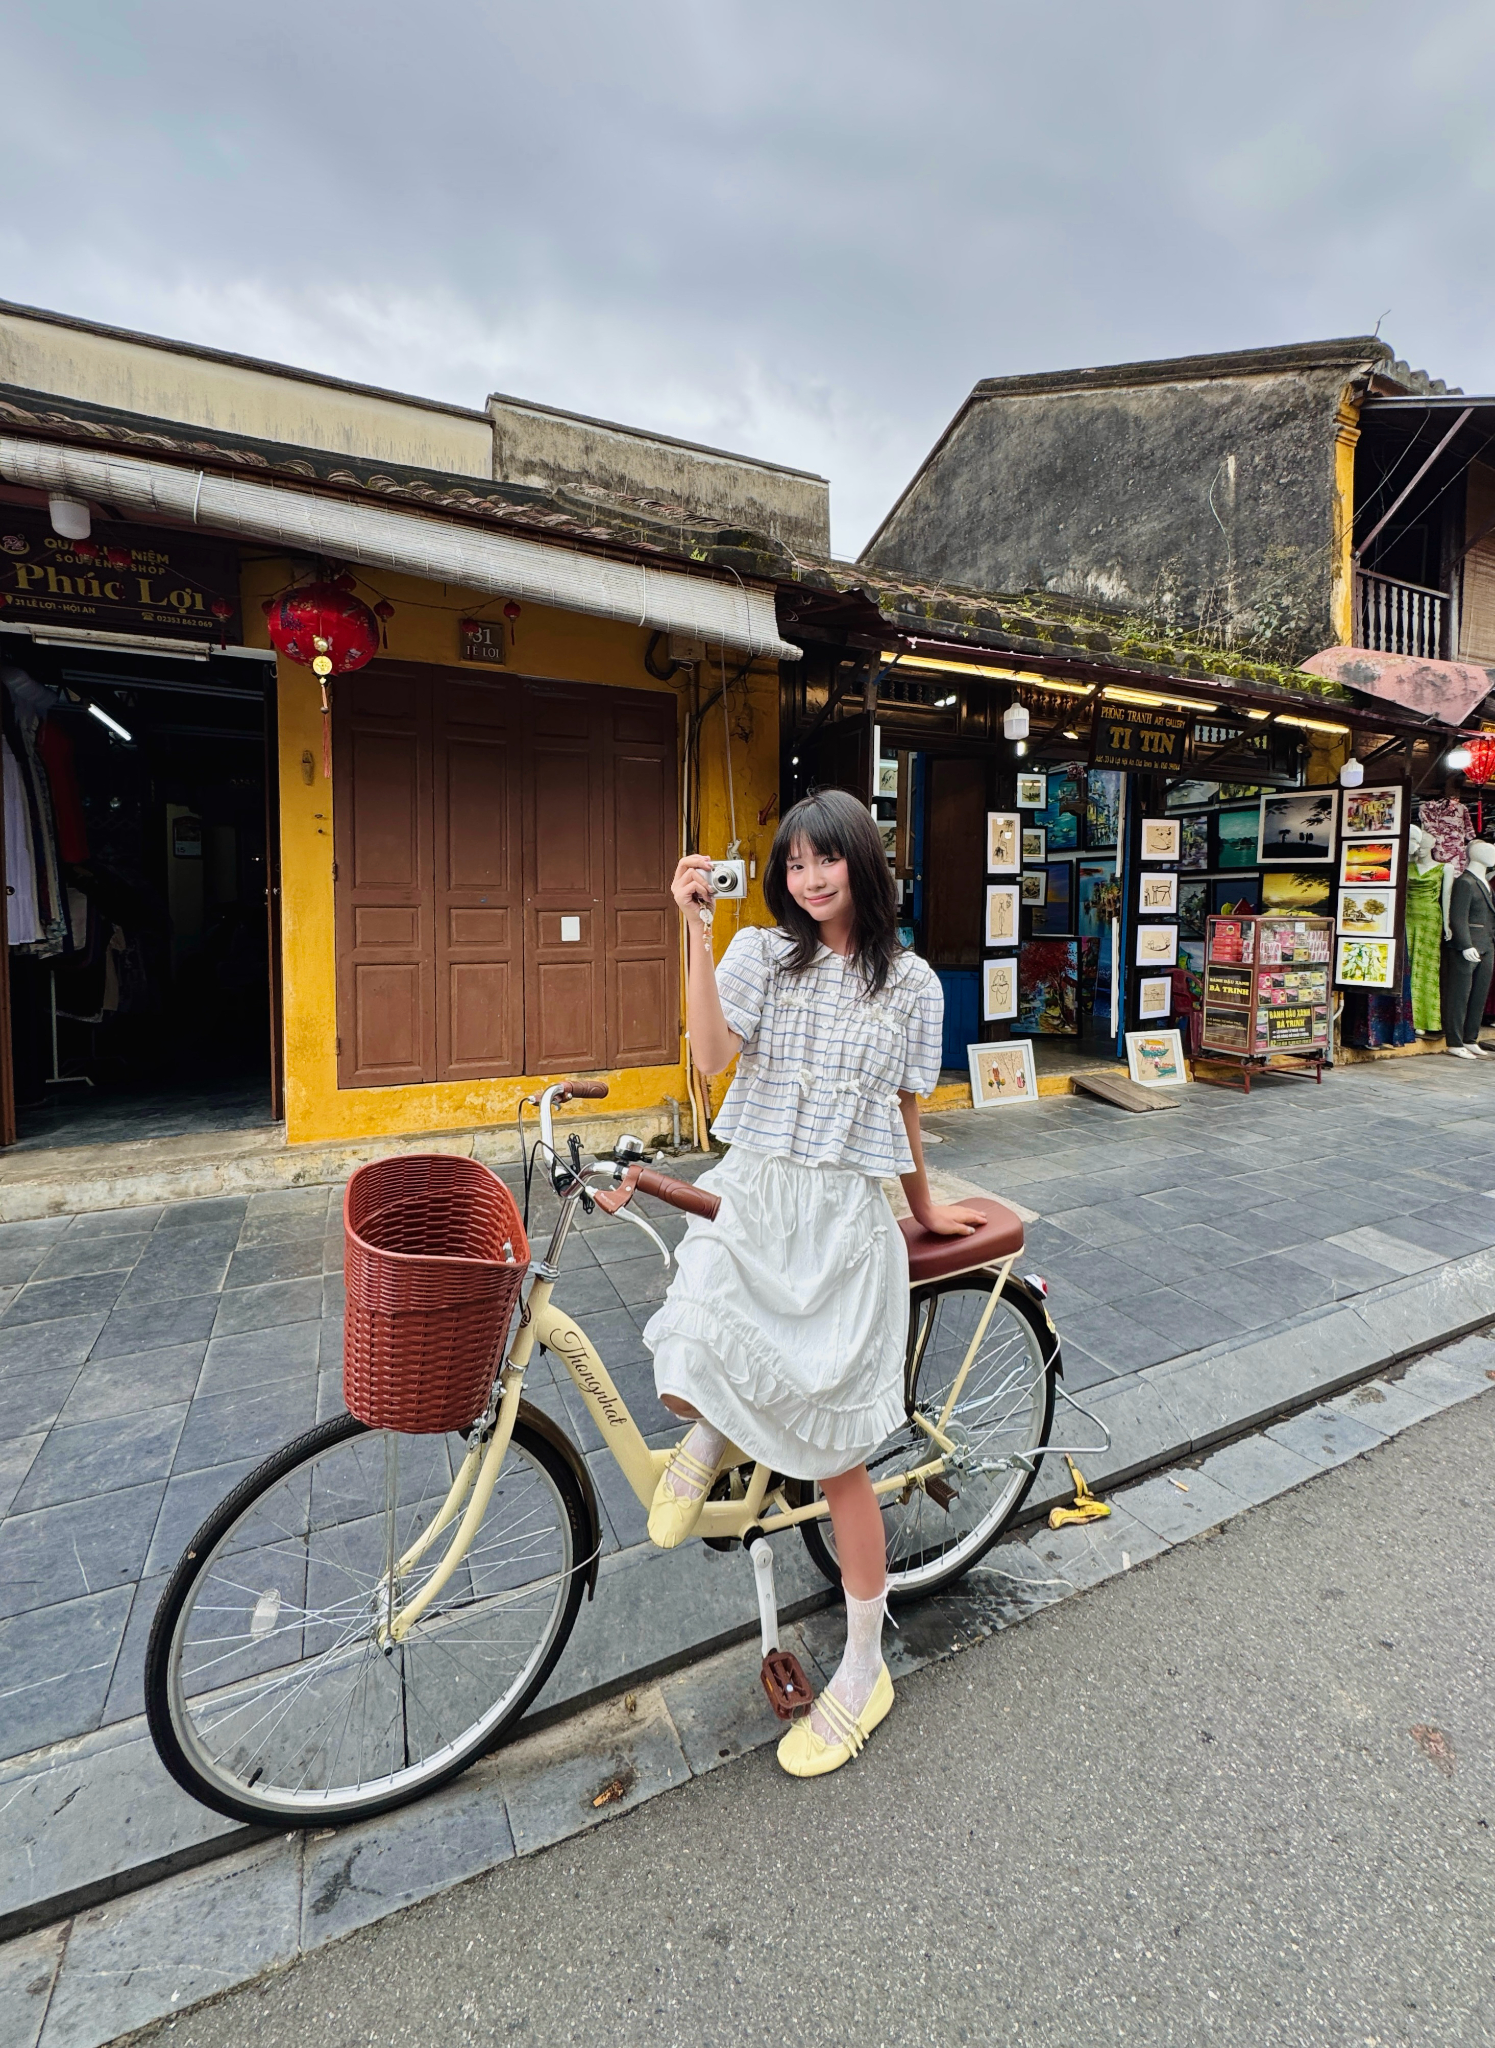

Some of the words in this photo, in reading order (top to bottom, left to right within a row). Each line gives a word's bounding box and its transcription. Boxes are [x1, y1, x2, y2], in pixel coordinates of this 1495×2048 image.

[130, 563, 166, 575] SHOP
[12, 561, 126, 601] Phúc
[135, 577, 206, 614] Lợi
[15, 598, 25, 606] 31
[82, 605, 96, 614] AN
[198, 619, 213, 628] 069
[472, 627, 493, 645] 31
[1127, 710, 1152, 724] TRANH
[1154, 716, 1164, 726] ART
[1165, 718, 1185, 729] GALLERY
[1109, 726, 1133, 750] TI
[1139, 729, 1176, 755] TIN
[1222, 986, 1250, 996] TRINH
[1286, 1018, 1306, 1028] TRINH
